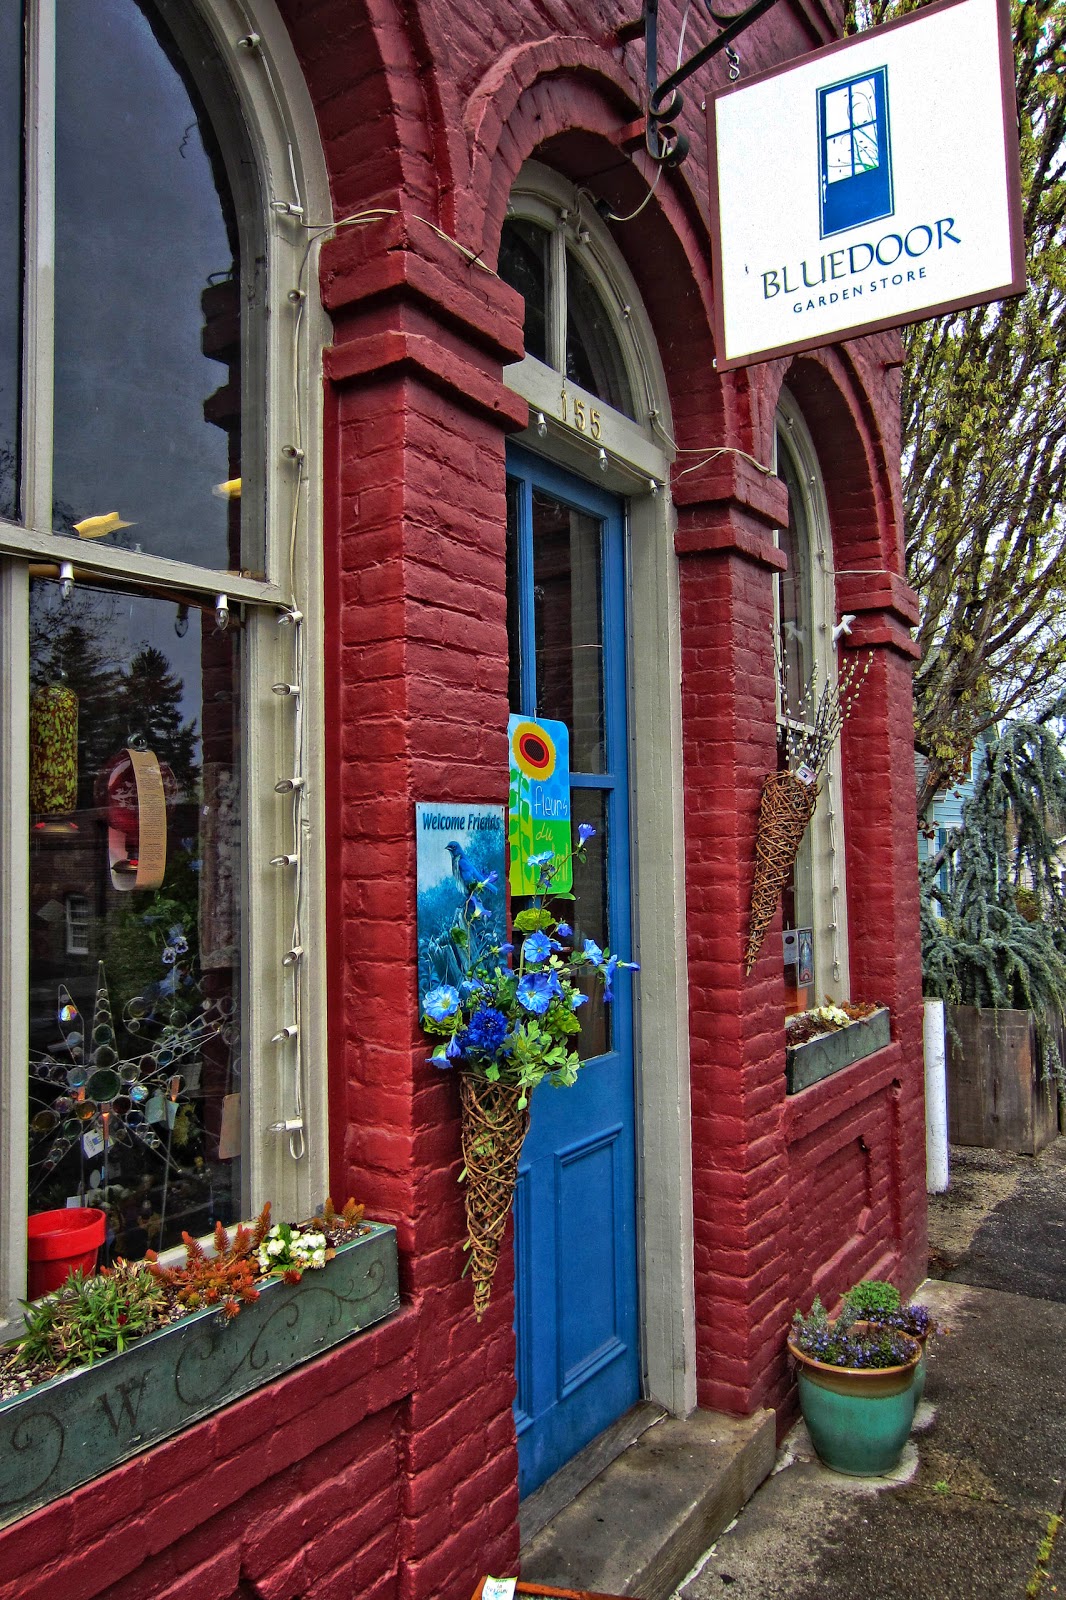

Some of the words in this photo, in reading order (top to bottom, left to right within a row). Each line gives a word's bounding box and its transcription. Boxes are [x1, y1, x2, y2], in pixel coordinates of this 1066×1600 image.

[761, 217, 962, 300] BLUEDOOR
[793, 285, 863, 313] GARDEN
[870, 267, 927, 292] STORE
[561, 389, 601, 440] 155
[534, 785, 568, 816] fleurs
[422, 812, 466, 831] Welcome
[467, 812, 501, 831] Friends
[536, 822, 553, 840] du
